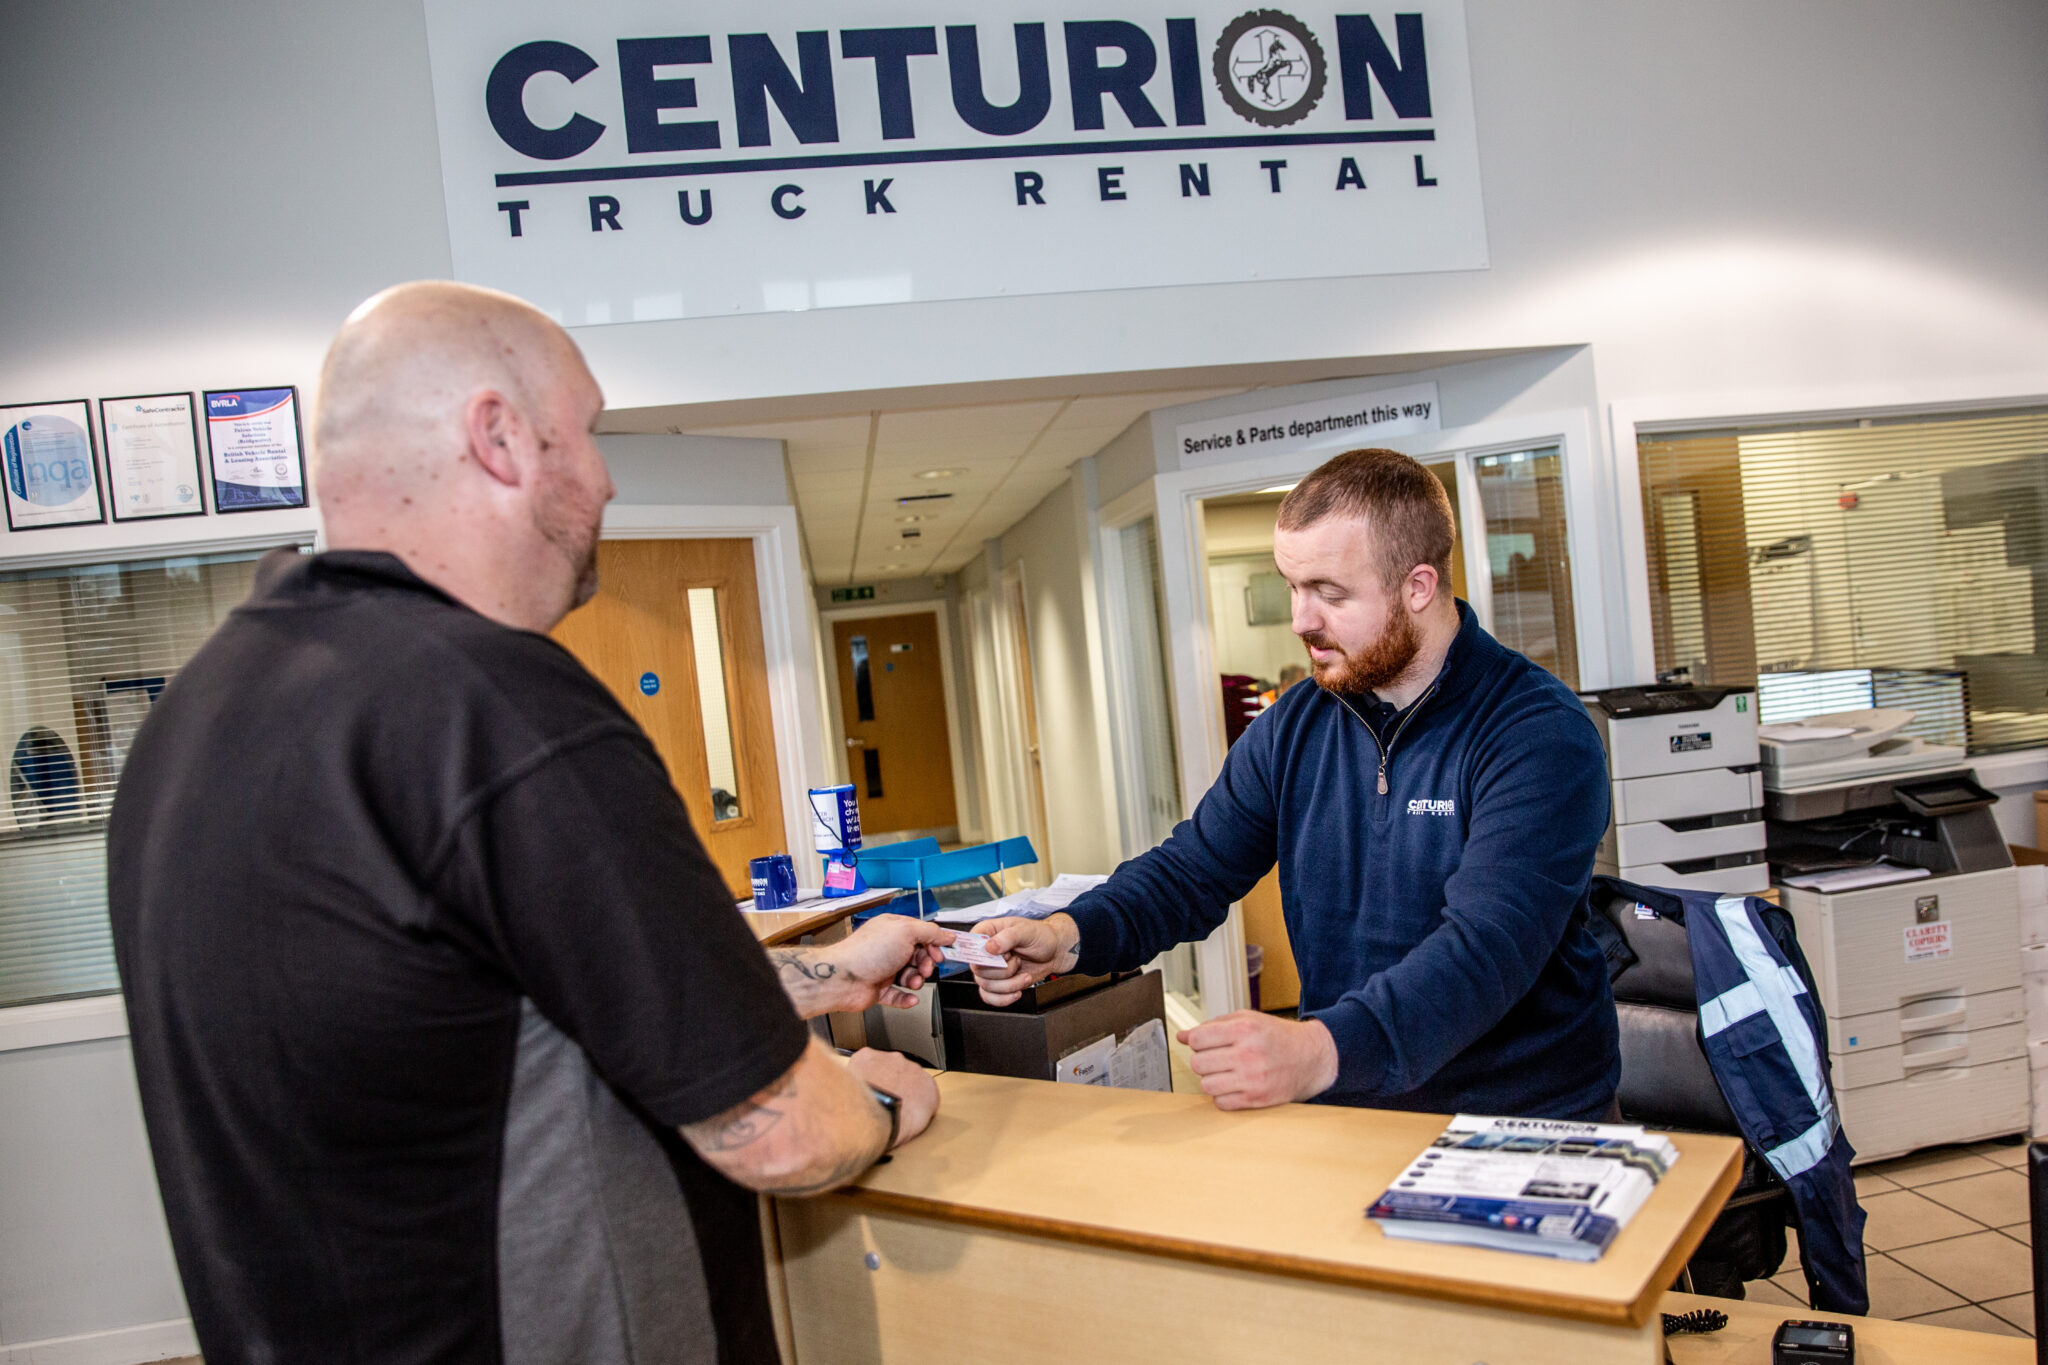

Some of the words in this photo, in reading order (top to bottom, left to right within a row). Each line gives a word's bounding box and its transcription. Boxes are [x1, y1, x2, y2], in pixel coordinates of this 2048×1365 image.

[486, 8, 1433, 160] CENTURION
[497, 178, 897, 237] TRUCK
[1014, 154, 1438, 206] RENTAL
[211, 399, 238, 408] BVRLA
[1184, 433, 1232, 454] Service
[1235, 429, 1246, 445] &
[1249, 425, 1285, 443] Parts
[1288, 410, 1368, 438] department
[1371, 404, 1399, 424] this
[1402, 401, 1432, 419] way
[27, 458, 89, 488] nqa
[1905, 924, 1948, 939] CLARITY
[1494, 1119, 1598, 1133] CENTURION
